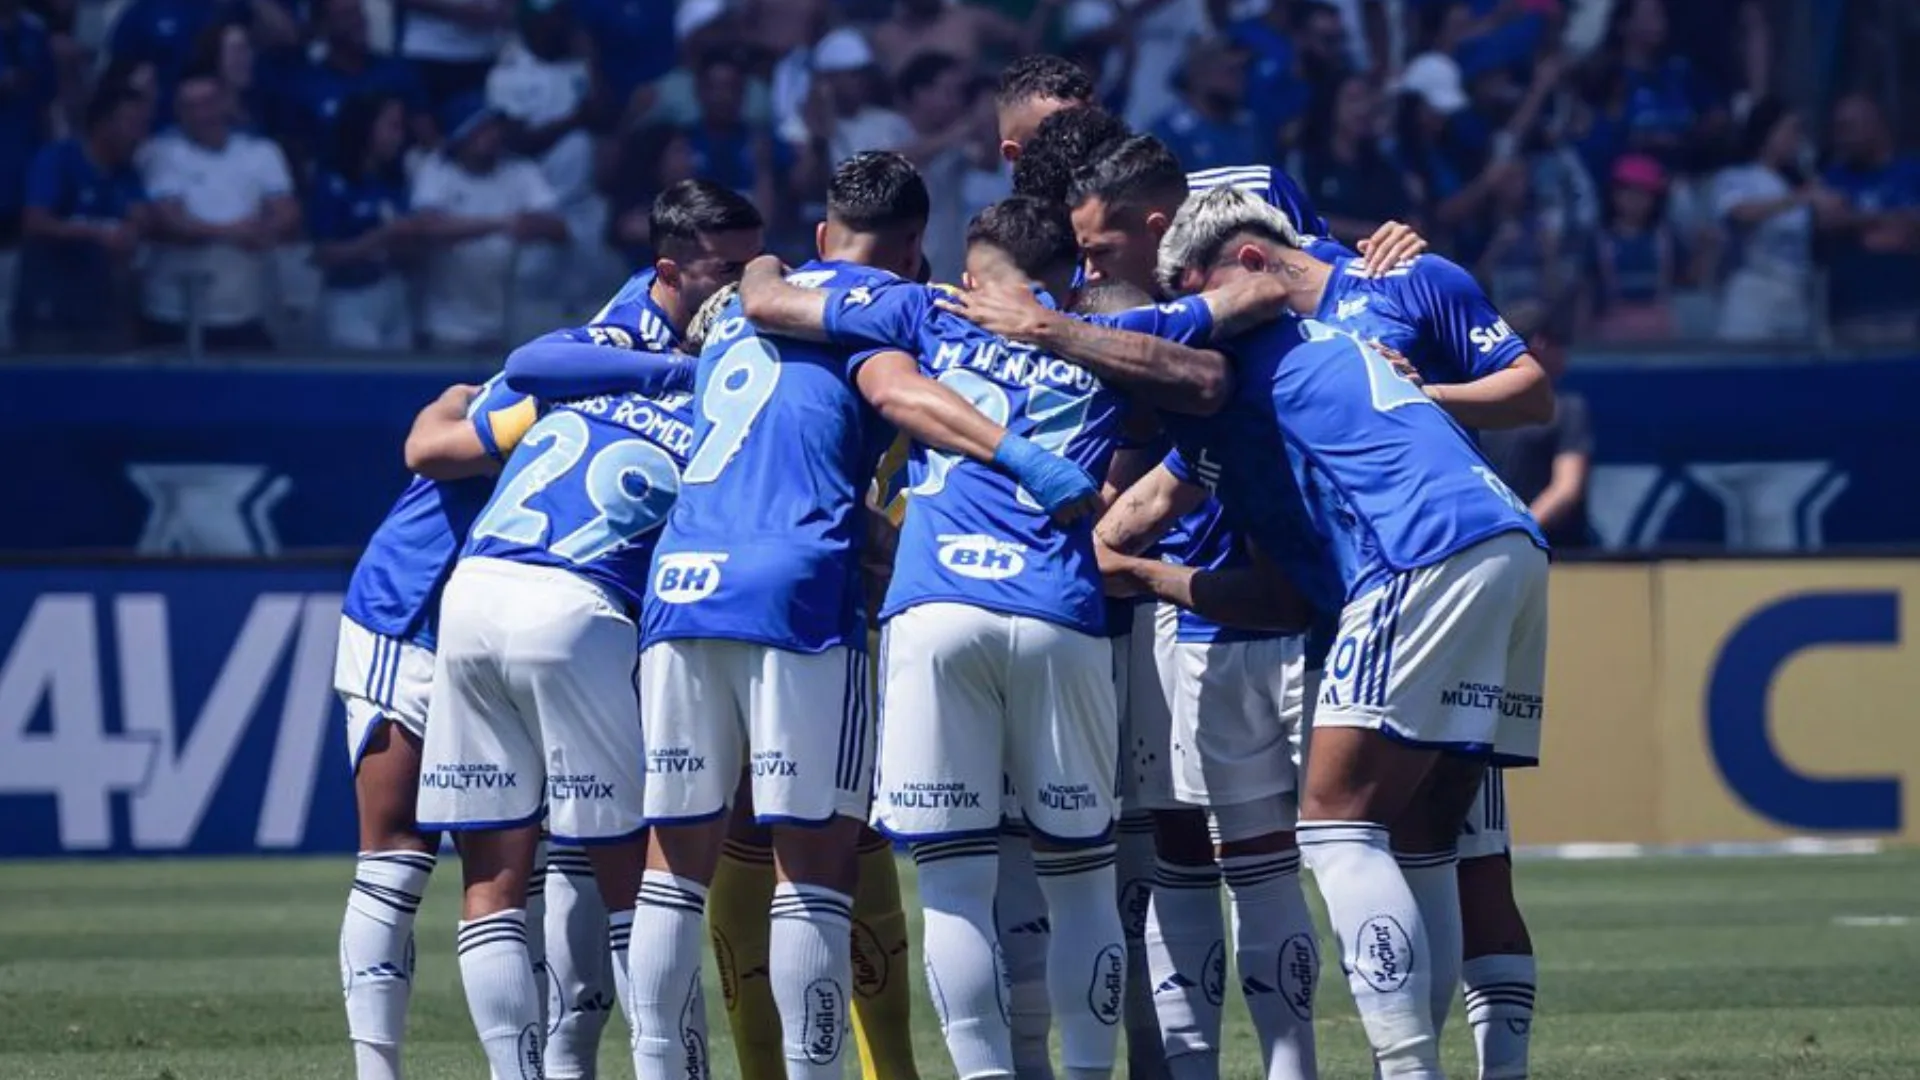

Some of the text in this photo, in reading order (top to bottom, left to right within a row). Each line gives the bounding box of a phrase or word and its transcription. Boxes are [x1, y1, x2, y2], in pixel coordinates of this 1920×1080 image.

[682, 335, 781, 484] 9
[473, 410, 680, 565] 29
[661, 566, 711, 592] BH
[950, 548, 1013, 570] BH
[1323, 635, 1356, 680] 0
[1703, 588, 1904, 834] C
[422, 773, 517, 789] MULTIVIX
[889, 791, 980, 808] MULTIVIX
[811, 987, 836, 1056] Kodilar
